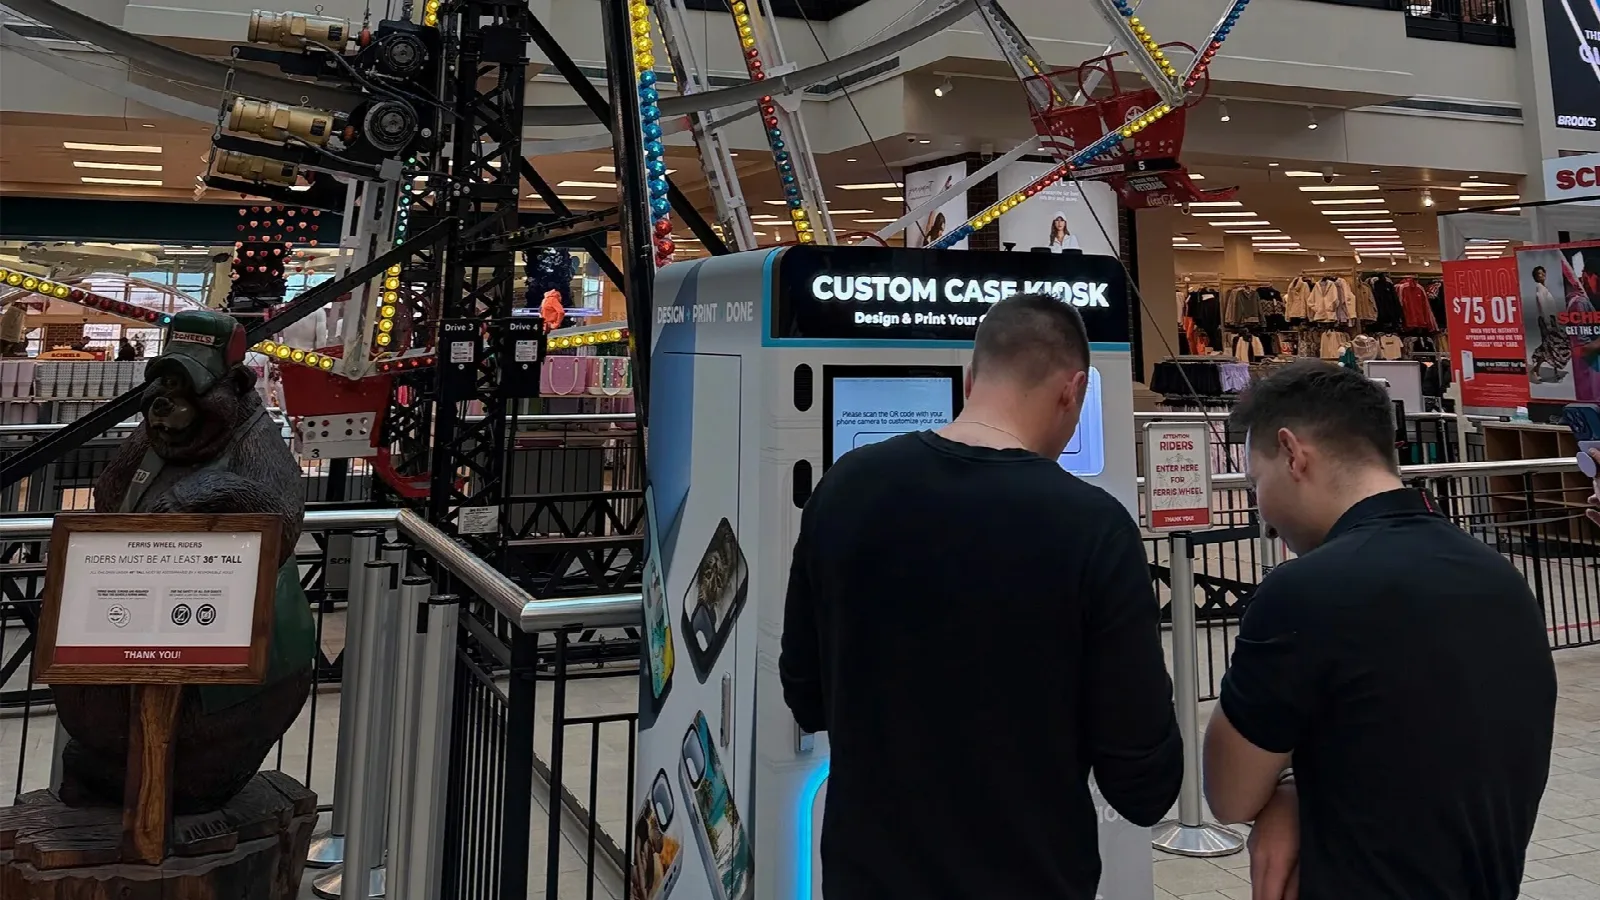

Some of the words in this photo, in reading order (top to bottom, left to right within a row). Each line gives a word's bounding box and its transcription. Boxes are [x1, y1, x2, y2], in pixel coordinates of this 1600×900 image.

[1557, 115, 1597, 127] BROOKS
[1138, 160, 1145, 171] 5
[1556, 166, 1600, 190] SC
[811, 275, 937, 302] CUSTOM
[944, 278, 1017, 303] CASE
[657, 305, 684, 324] DESIGN
[692, 303, 718, 323] PRINT
[726, 301, 753, 322] DONE
[1453, 296, 1486, 324] $75
[1491, 296, 1519, 324] OF
[854, 312, 899, 327] Design
[902, 313, 912, 324] &
[915, 312, 946, 325] Print
[948, 313, 977, 325] Your
[444, 323, 465, 331] Drive
[468, 323, 474, 331] 3
[509, 322, 530, 331] Drive
[532, 322, 539, 331] 4
[1565, 326, 1578, 335] GET
[1579, 326, 1593, 335] THE
[842, 410, 862, 418] Please
[878, 410, 888, 418] the
[889, 410, 898, 418] QR
[900, 410, 914, 418] code
[916, 410, 929, 418] with
[836, 418, 856, 426] phone
[1159, 441, 1194, 451] RIDERS
[311, 448, 320, 459] 3
[1156, 464, 1179, 473] ENTER
[1180, 463, 1199, 472] HERE
[1153, 488, 1177, 496] FERRIS
[1178, 487, 1203, 495] WHEEL
[127, 541, 151, 549] FERRIS
[84, 555, 116, 564] RIDERS
[118, 555, 145, 564] MUST
[146, 555, 158, 564] BE
[160, 555, 172, 564] AT
[173, 555, 201, 564] LEAST
[221, 555, 242, 564] TALL
[124, 650, 156, 659] THANK
[158, 650, 181, 659] YOU!
